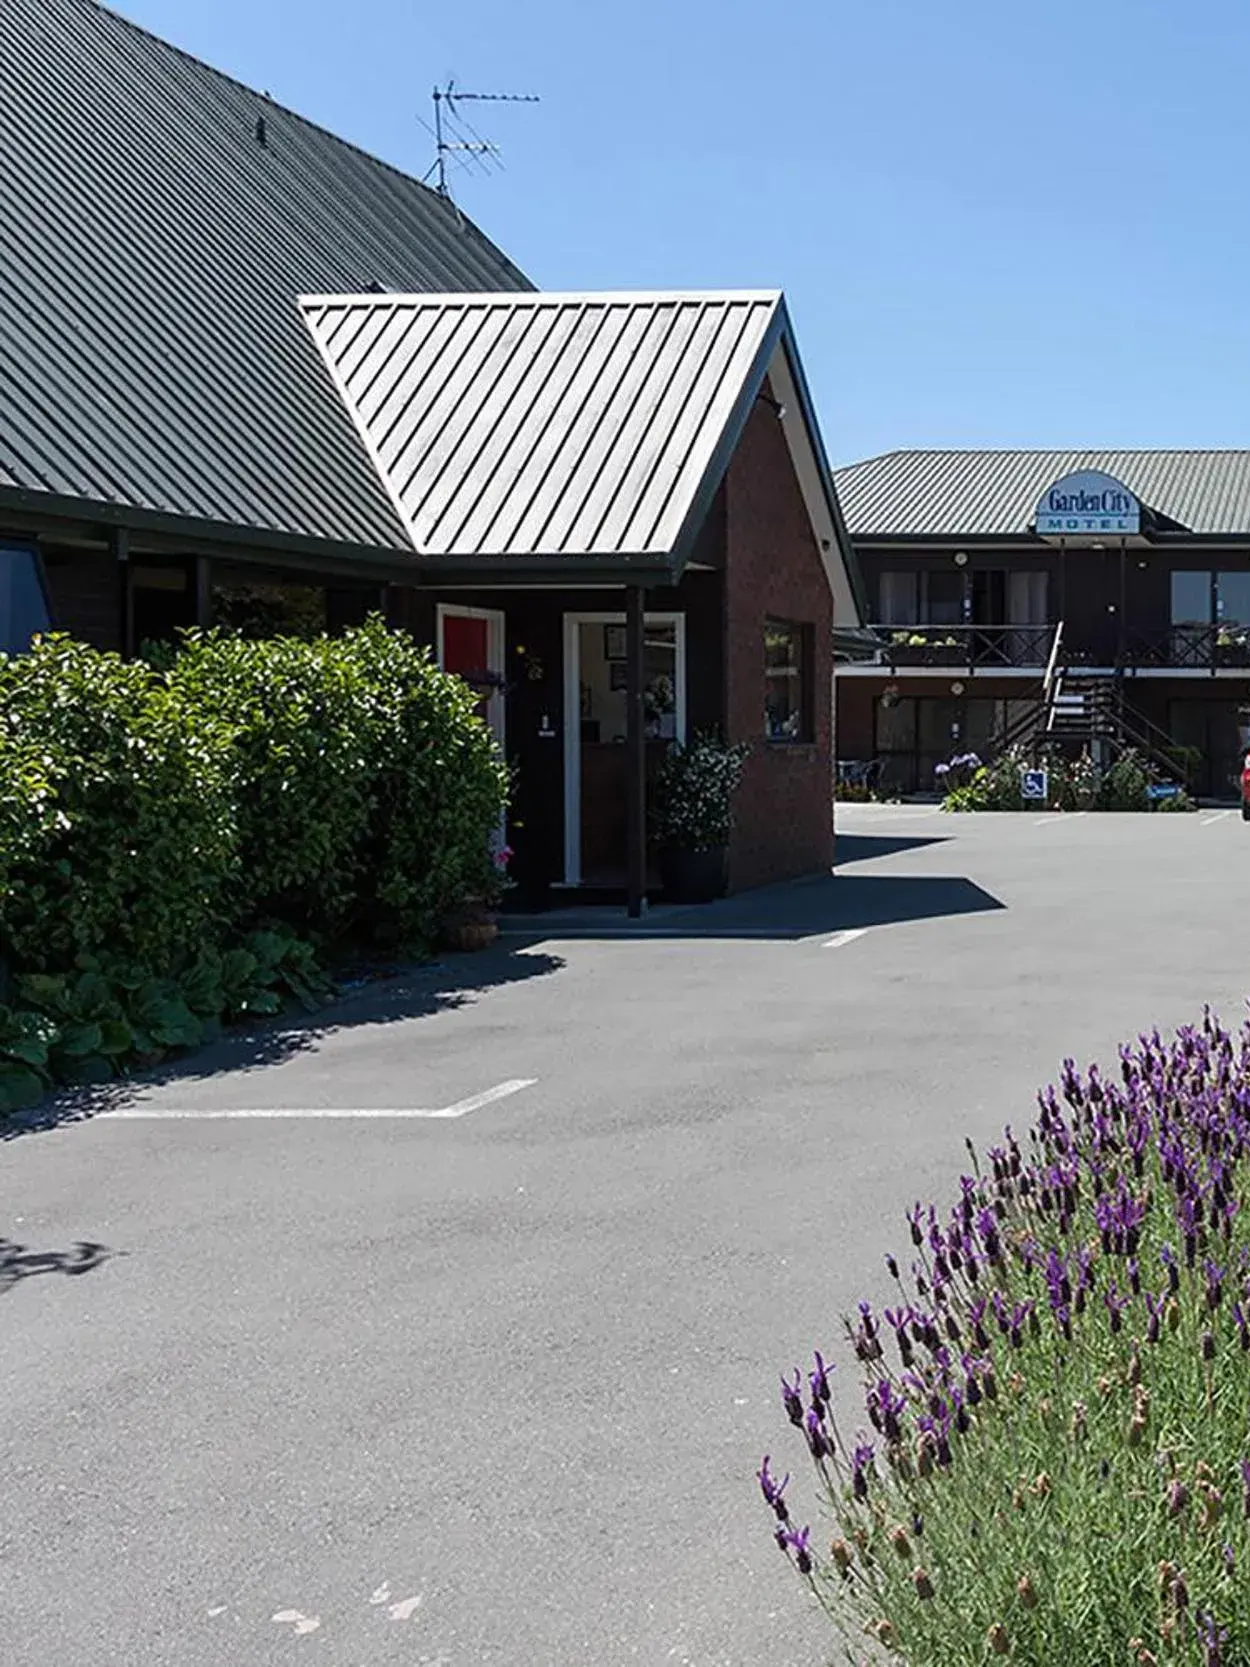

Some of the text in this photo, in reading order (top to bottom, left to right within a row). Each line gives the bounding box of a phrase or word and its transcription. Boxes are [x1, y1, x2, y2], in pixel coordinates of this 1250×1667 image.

[1049, 489, 1130, 517] Garden City
[1048, 520, 1127, 529] MOTEL
